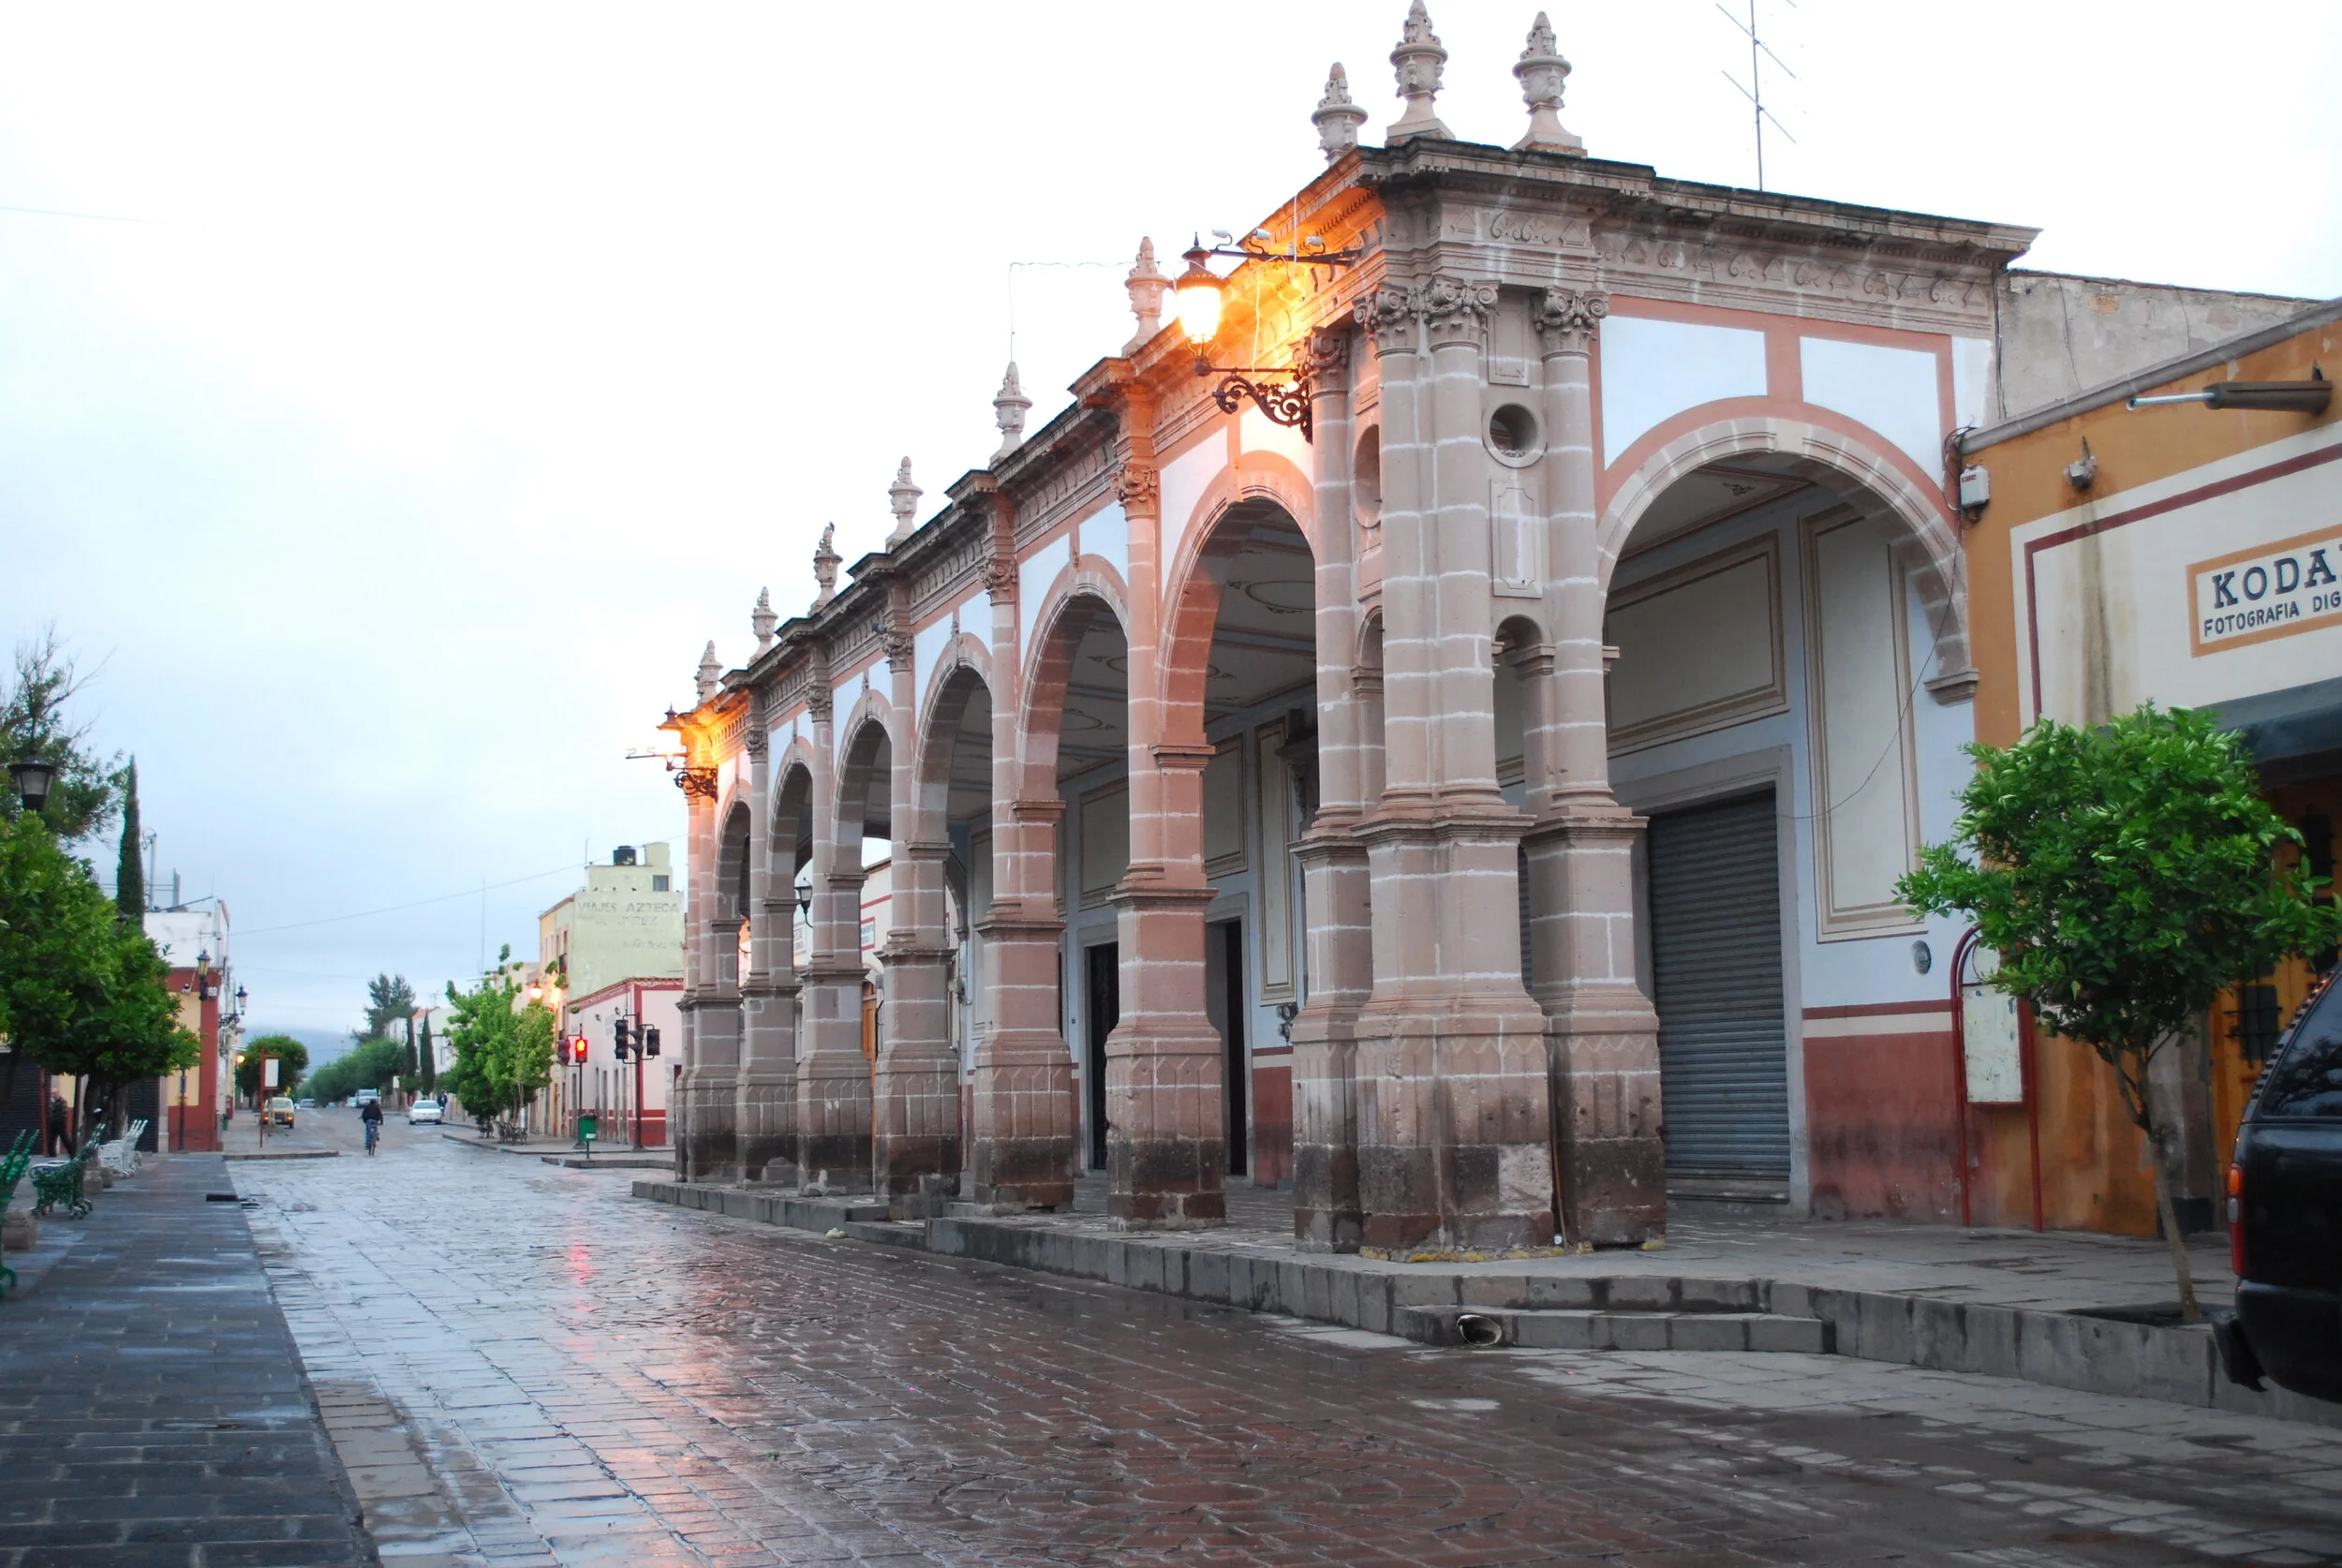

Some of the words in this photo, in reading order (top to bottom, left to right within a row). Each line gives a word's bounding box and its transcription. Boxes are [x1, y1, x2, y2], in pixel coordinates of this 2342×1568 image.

[2212, 544, 2342, 609] KODA
[2203, 600, 2300, 637] FOTOGRAFIA
[577, 901, 617, 912] VIAJES
[626, 902, 679, 912] AZTECA
